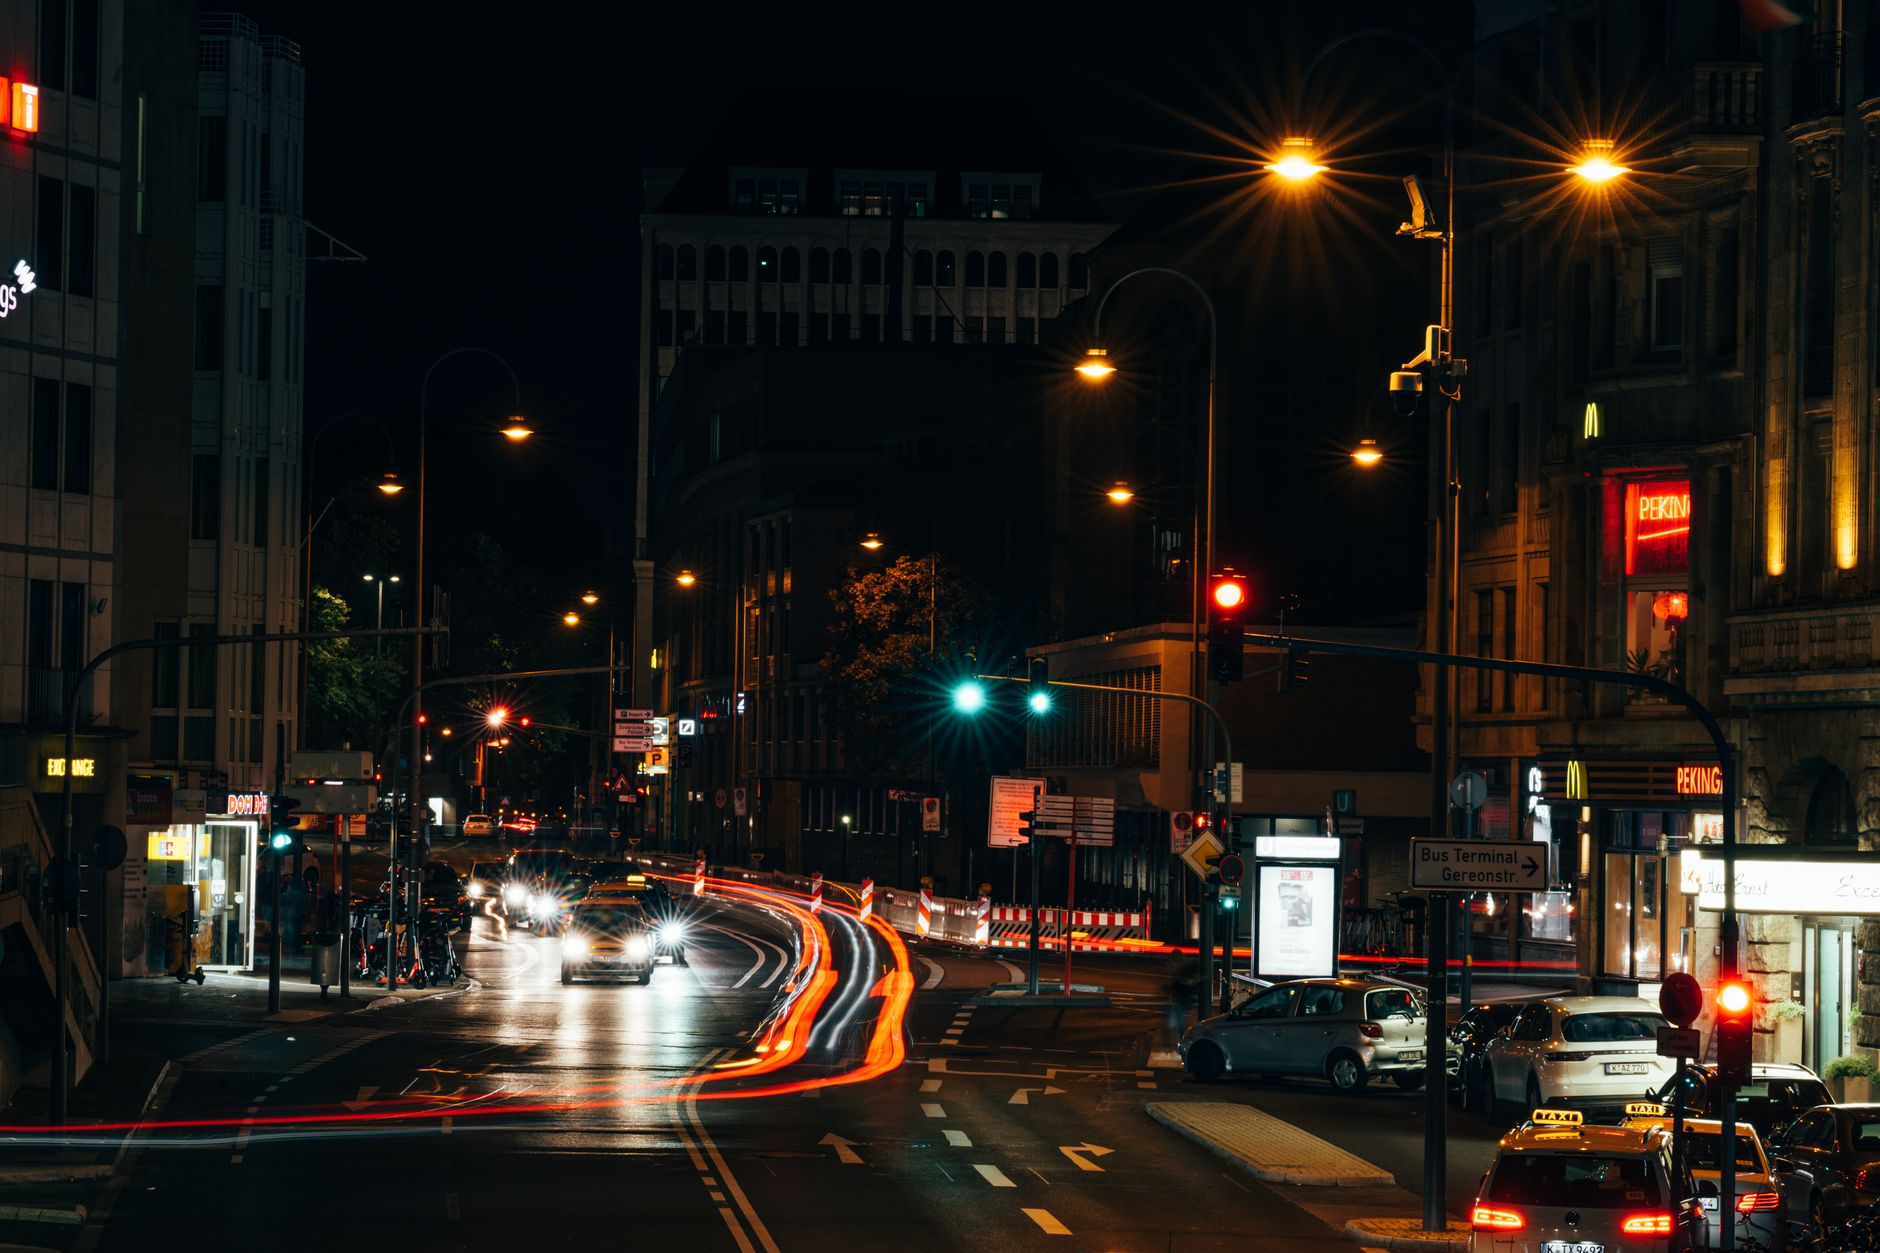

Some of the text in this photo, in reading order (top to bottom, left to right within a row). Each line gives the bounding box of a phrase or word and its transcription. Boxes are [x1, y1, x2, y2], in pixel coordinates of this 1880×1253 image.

[47, 758, 95, 777] EXCANGE
[1677, 766, 1721, 794] PEKING
[227, 795, 253, 815] DOM
[1421, 847, 1518, 864] Bus Terminal
[1442, 867, 1519, 883] Gereonstr.
[1541, 1111, 1573, 1121] TAXI
[1634, 1104, 1657, 1113] TAXI
